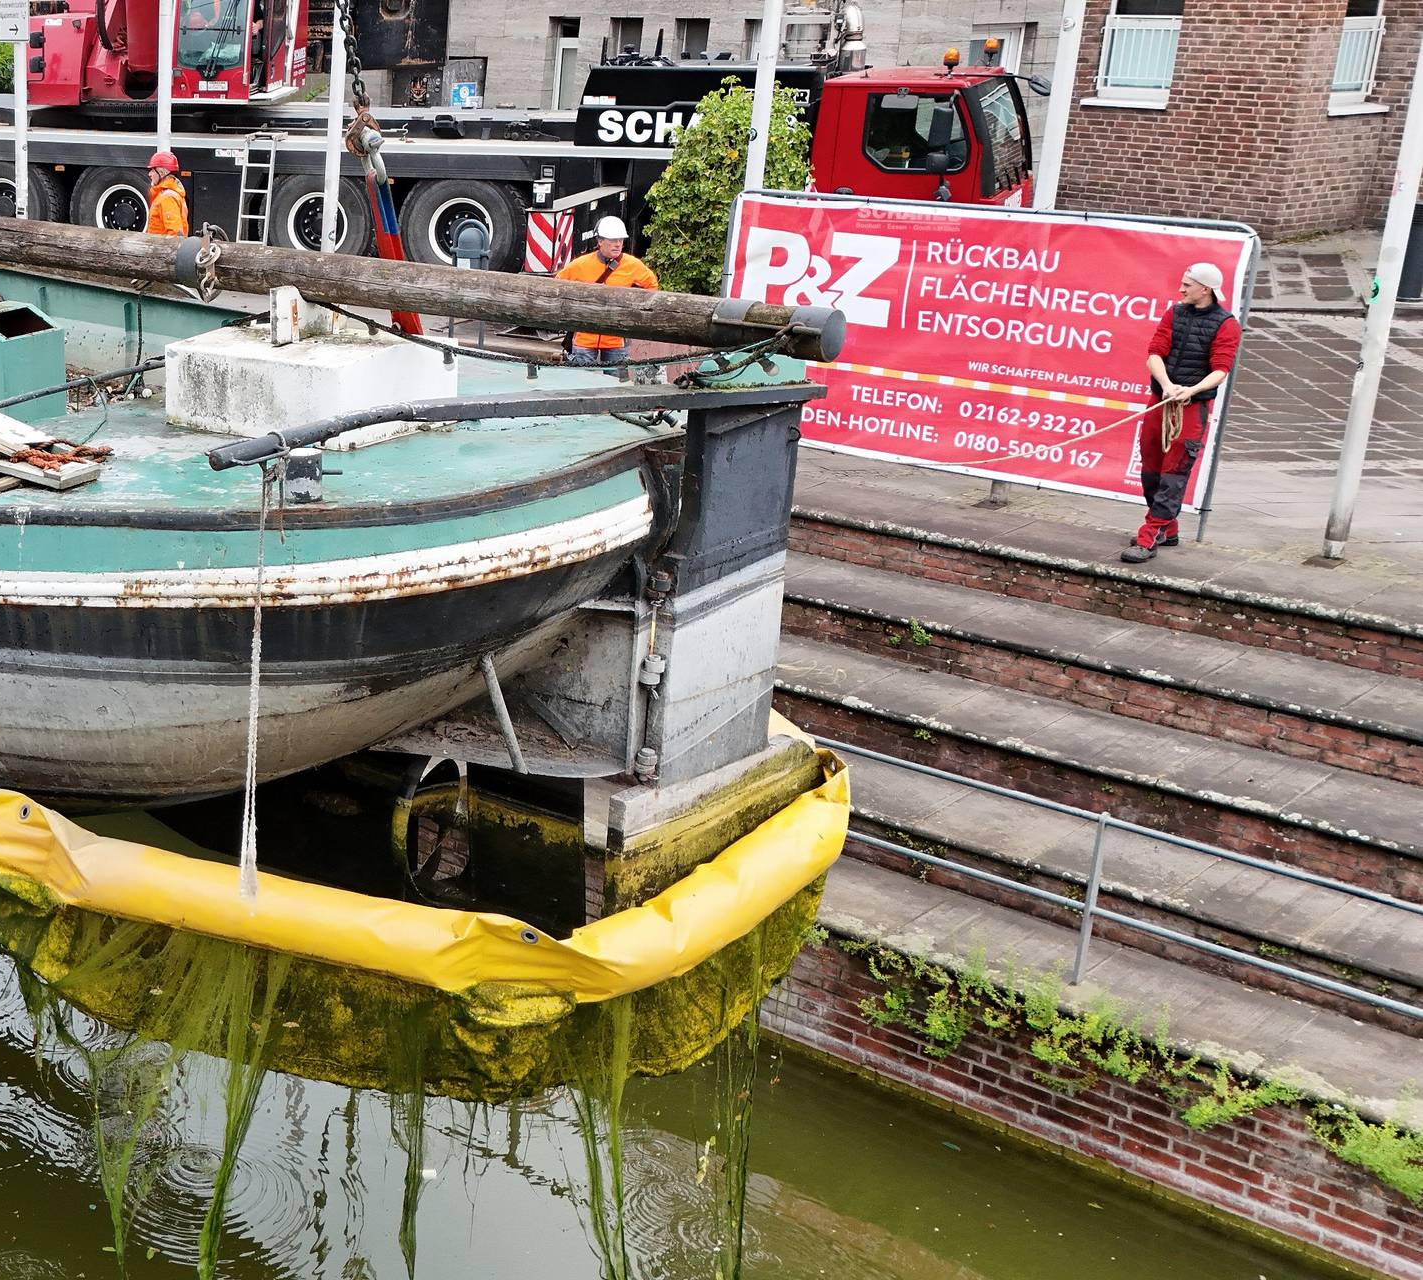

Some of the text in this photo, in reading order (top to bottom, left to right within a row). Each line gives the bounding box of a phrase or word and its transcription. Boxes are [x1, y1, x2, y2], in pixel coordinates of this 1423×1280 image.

[926, 238, 1061, 273] RÜCKBAU
[740, 226, 902, 328] P&Z
[919, 273, 1175, 322] FLÄCHENRECYCL
[916, 310, 1114, 353] ENTSORGUNG
[968, 360, 990, 374] WIR
[990, 364, 1054, 382] SCHAFFEN
[1056, 372, 1093, 387] PLATZ
[1094, 376, 1118, 391] FÜR
[1121, 381, 1143, 395] DIE
[851, 384, 943, 414] TELEFON:
[801, 407, 939, 443] DEN-HOTLINE:
